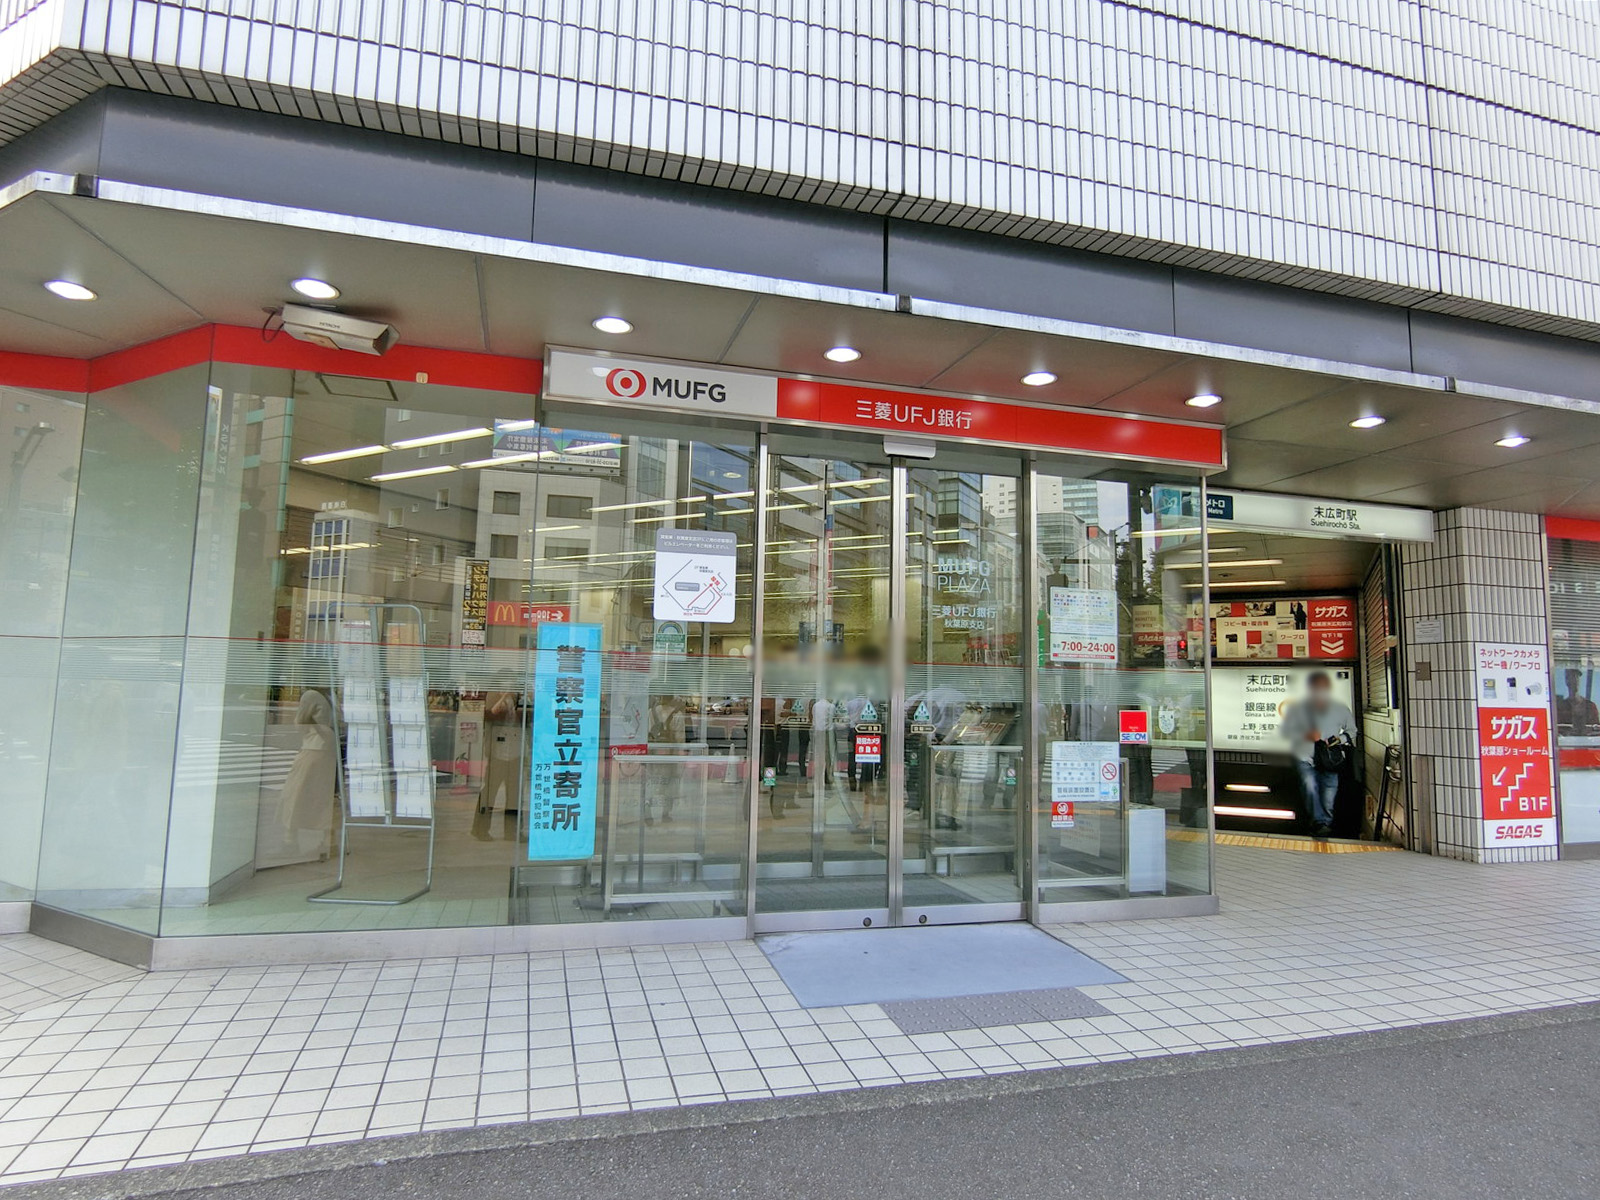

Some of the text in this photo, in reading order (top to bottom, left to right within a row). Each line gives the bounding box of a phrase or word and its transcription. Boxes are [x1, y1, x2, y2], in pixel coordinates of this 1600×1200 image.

[653, 377, 726, 403] MUFG
[856, 400, 972, 429] 三菱UFJ銀行
[1314, 506, 1357, 521] 末広町駅
[1349, 522, 1361, 530] Sta.
[938, 557, 990, 576] MUFG
[937, 575, 991, 593] PLAZA
[932, 605, 996, 619] 三菱UFJ銀行
[1315, 606, 1348, 618] サガス
[1480, 648, 1540, 658] ネットワークカメラ
[1245, 702, 1277, 712] 銀座線
[1491, 715, 1537, 740] サガス
[551, 645, 585, 832] 警察官立寄所
[1121, 733, 1146, 741] SECOM
[1481, 745, 1549, 756] 秋葉原ショールーム
[1519, 797, 1548, 812] B1F
[1495, 825, 1543, 840] SAGAS
